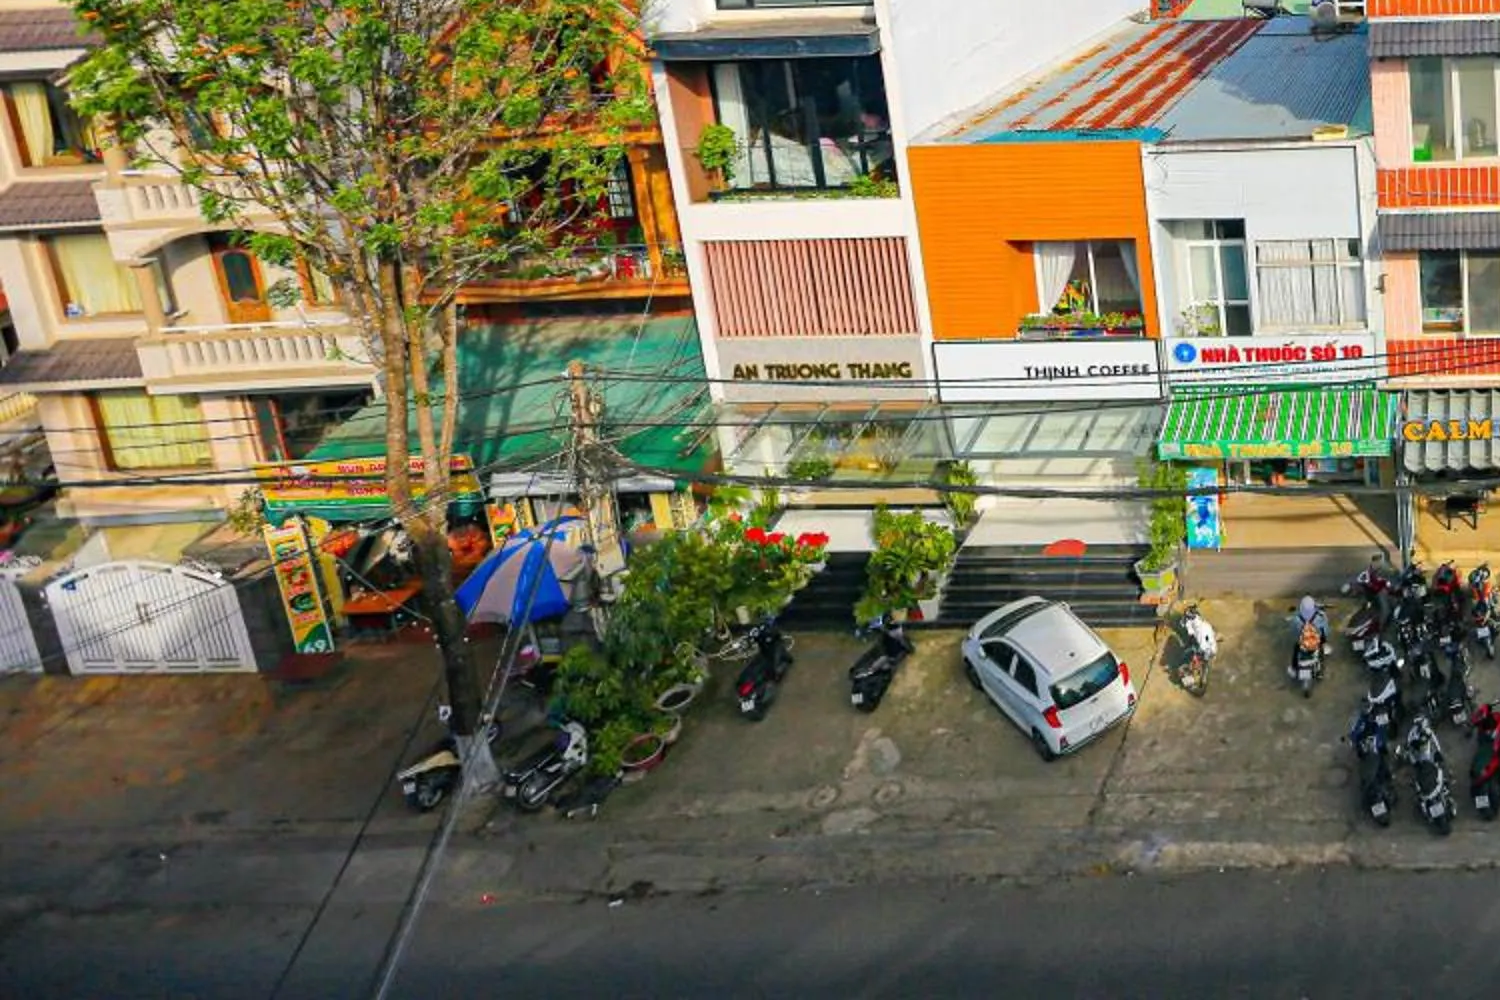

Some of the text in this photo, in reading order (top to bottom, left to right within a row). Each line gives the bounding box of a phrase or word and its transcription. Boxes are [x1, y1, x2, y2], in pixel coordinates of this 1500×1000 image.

[1200, 340, 1363, 363] NHÀ THUỐC SỐ 10
[733, 364, 758, 379] AN
[1087, 363, 1150, 376] COFFEE
[1403, 418, 1493, 441] CALM
